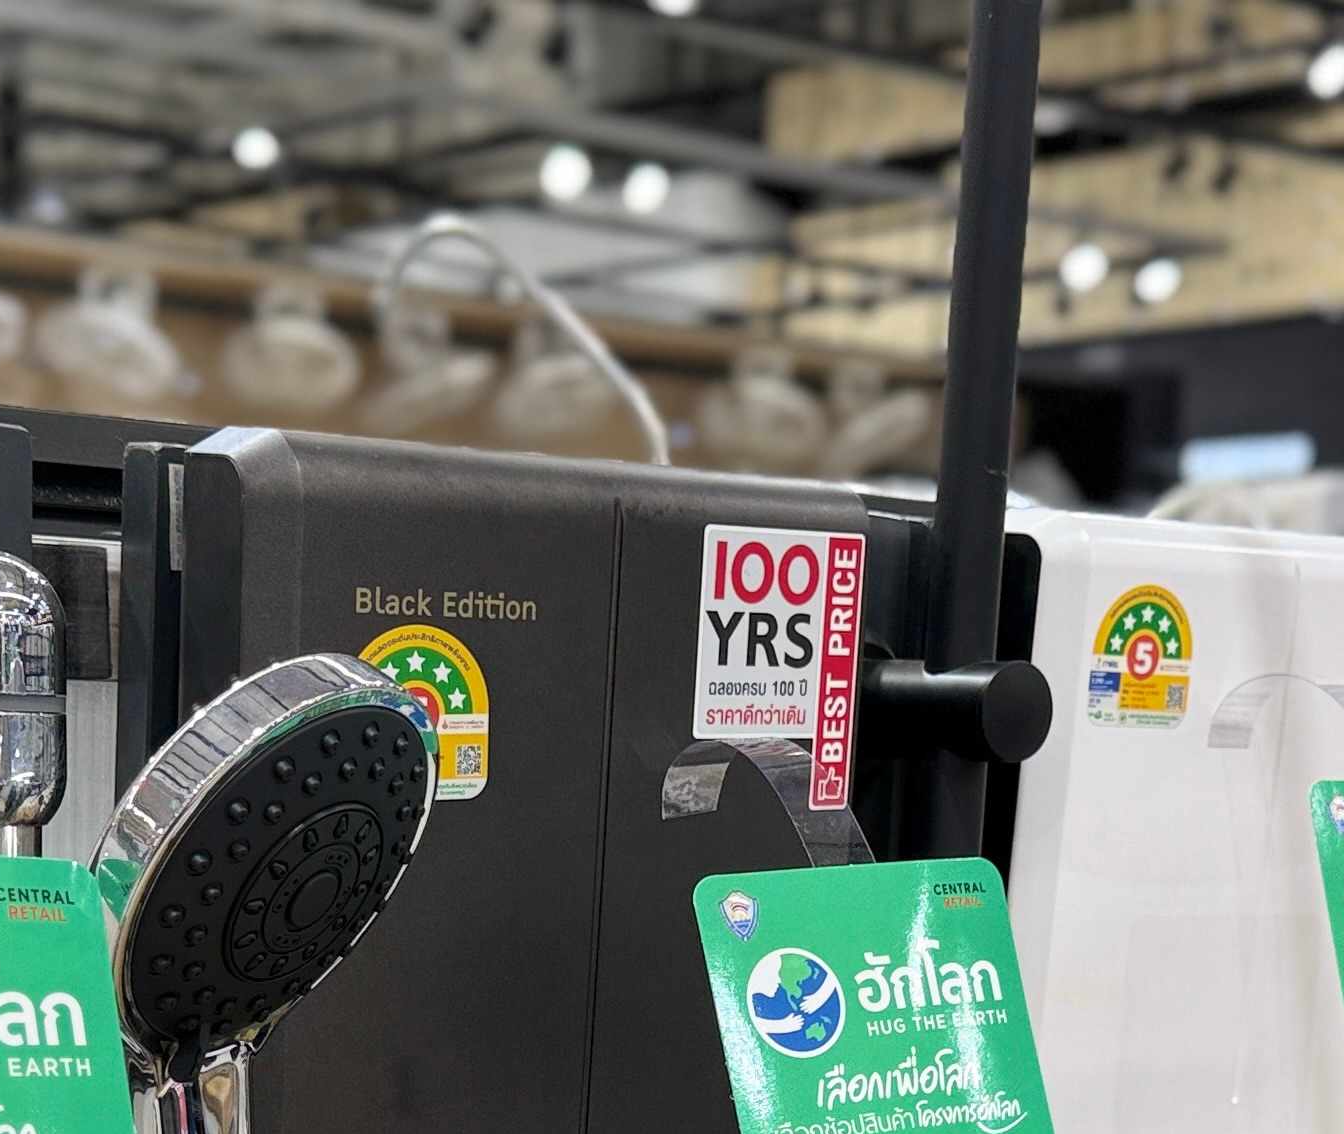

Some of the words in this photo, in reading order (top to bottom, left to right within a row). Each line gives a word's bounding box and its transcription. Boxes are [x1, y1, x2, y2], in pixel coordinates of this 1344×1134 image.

[356, 586, 433, 617] Black
[443, 590, 537, 621] Edition
[828, 548, 857, 657] PRICE
[706, 610, 814, 669] YRS
[1133, 640, 1154, 676] 5
[708, 679, 767, 697] ฉลองครบ
[772, 680, 795, 698] 100
[705, 703, 807, 727] ราคาดีกว่าเดิม
[820, 672, 850, 764] BEST
[933, 882, 987, 896] CENTRAL
[7, 905, 68, 923] RETAIL
[854, 937, 1004, 1013] ฮักโลก
[867, 1018, 907, 1038] HUG
[913, 1014, 947, 1032] THE
[952, 1008, 1009, 1029] EARTH
[8, 1057, 92, 1078] EARTH
[816, 1046, 982, 1112] เลือกเพื่อโลก
